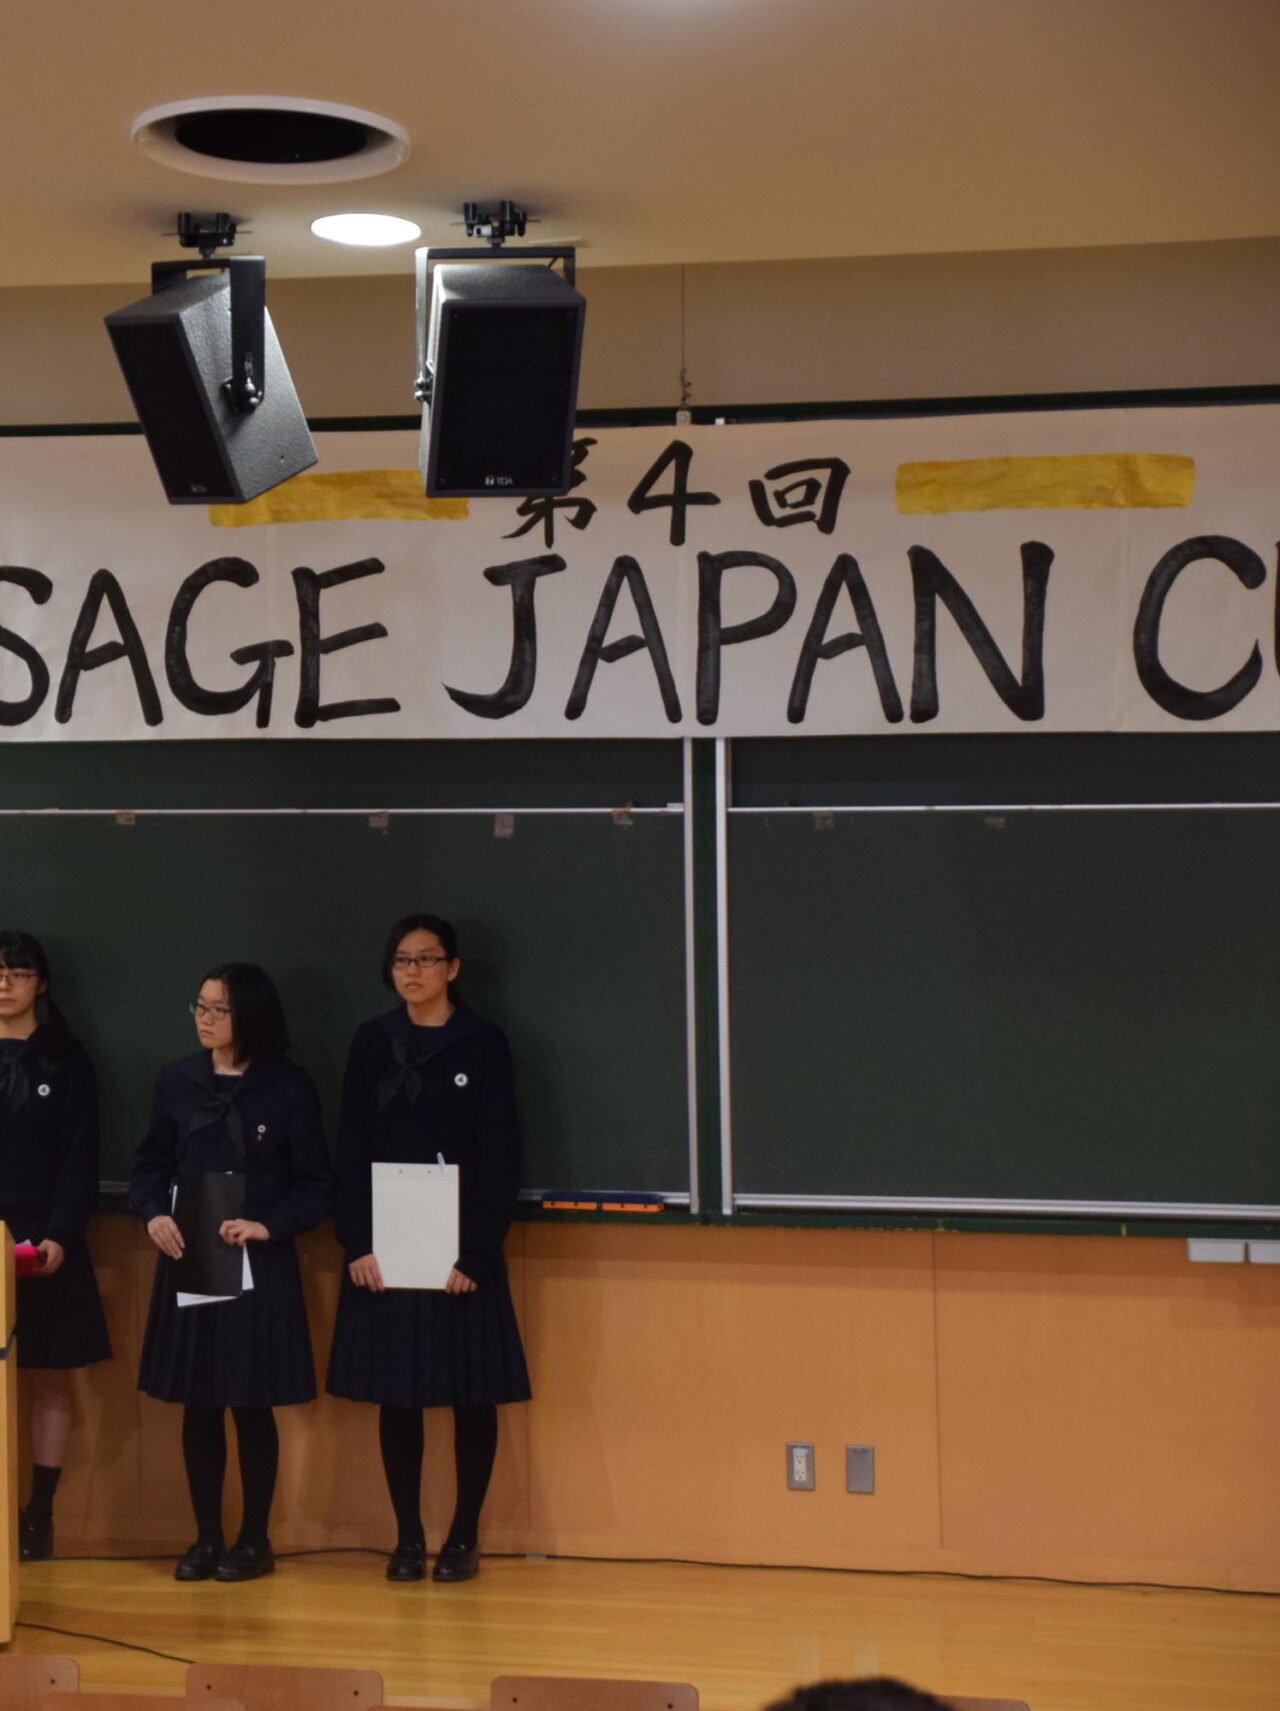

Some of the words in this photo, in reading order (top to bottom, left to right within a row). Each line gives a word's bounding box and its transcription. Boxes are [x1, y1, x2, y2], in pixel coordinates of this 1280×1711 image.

[496, 477, 513, 486] TOA
[442, 541, 1055, 726] JAPAN
[1132, 535, 1280, 720] C
